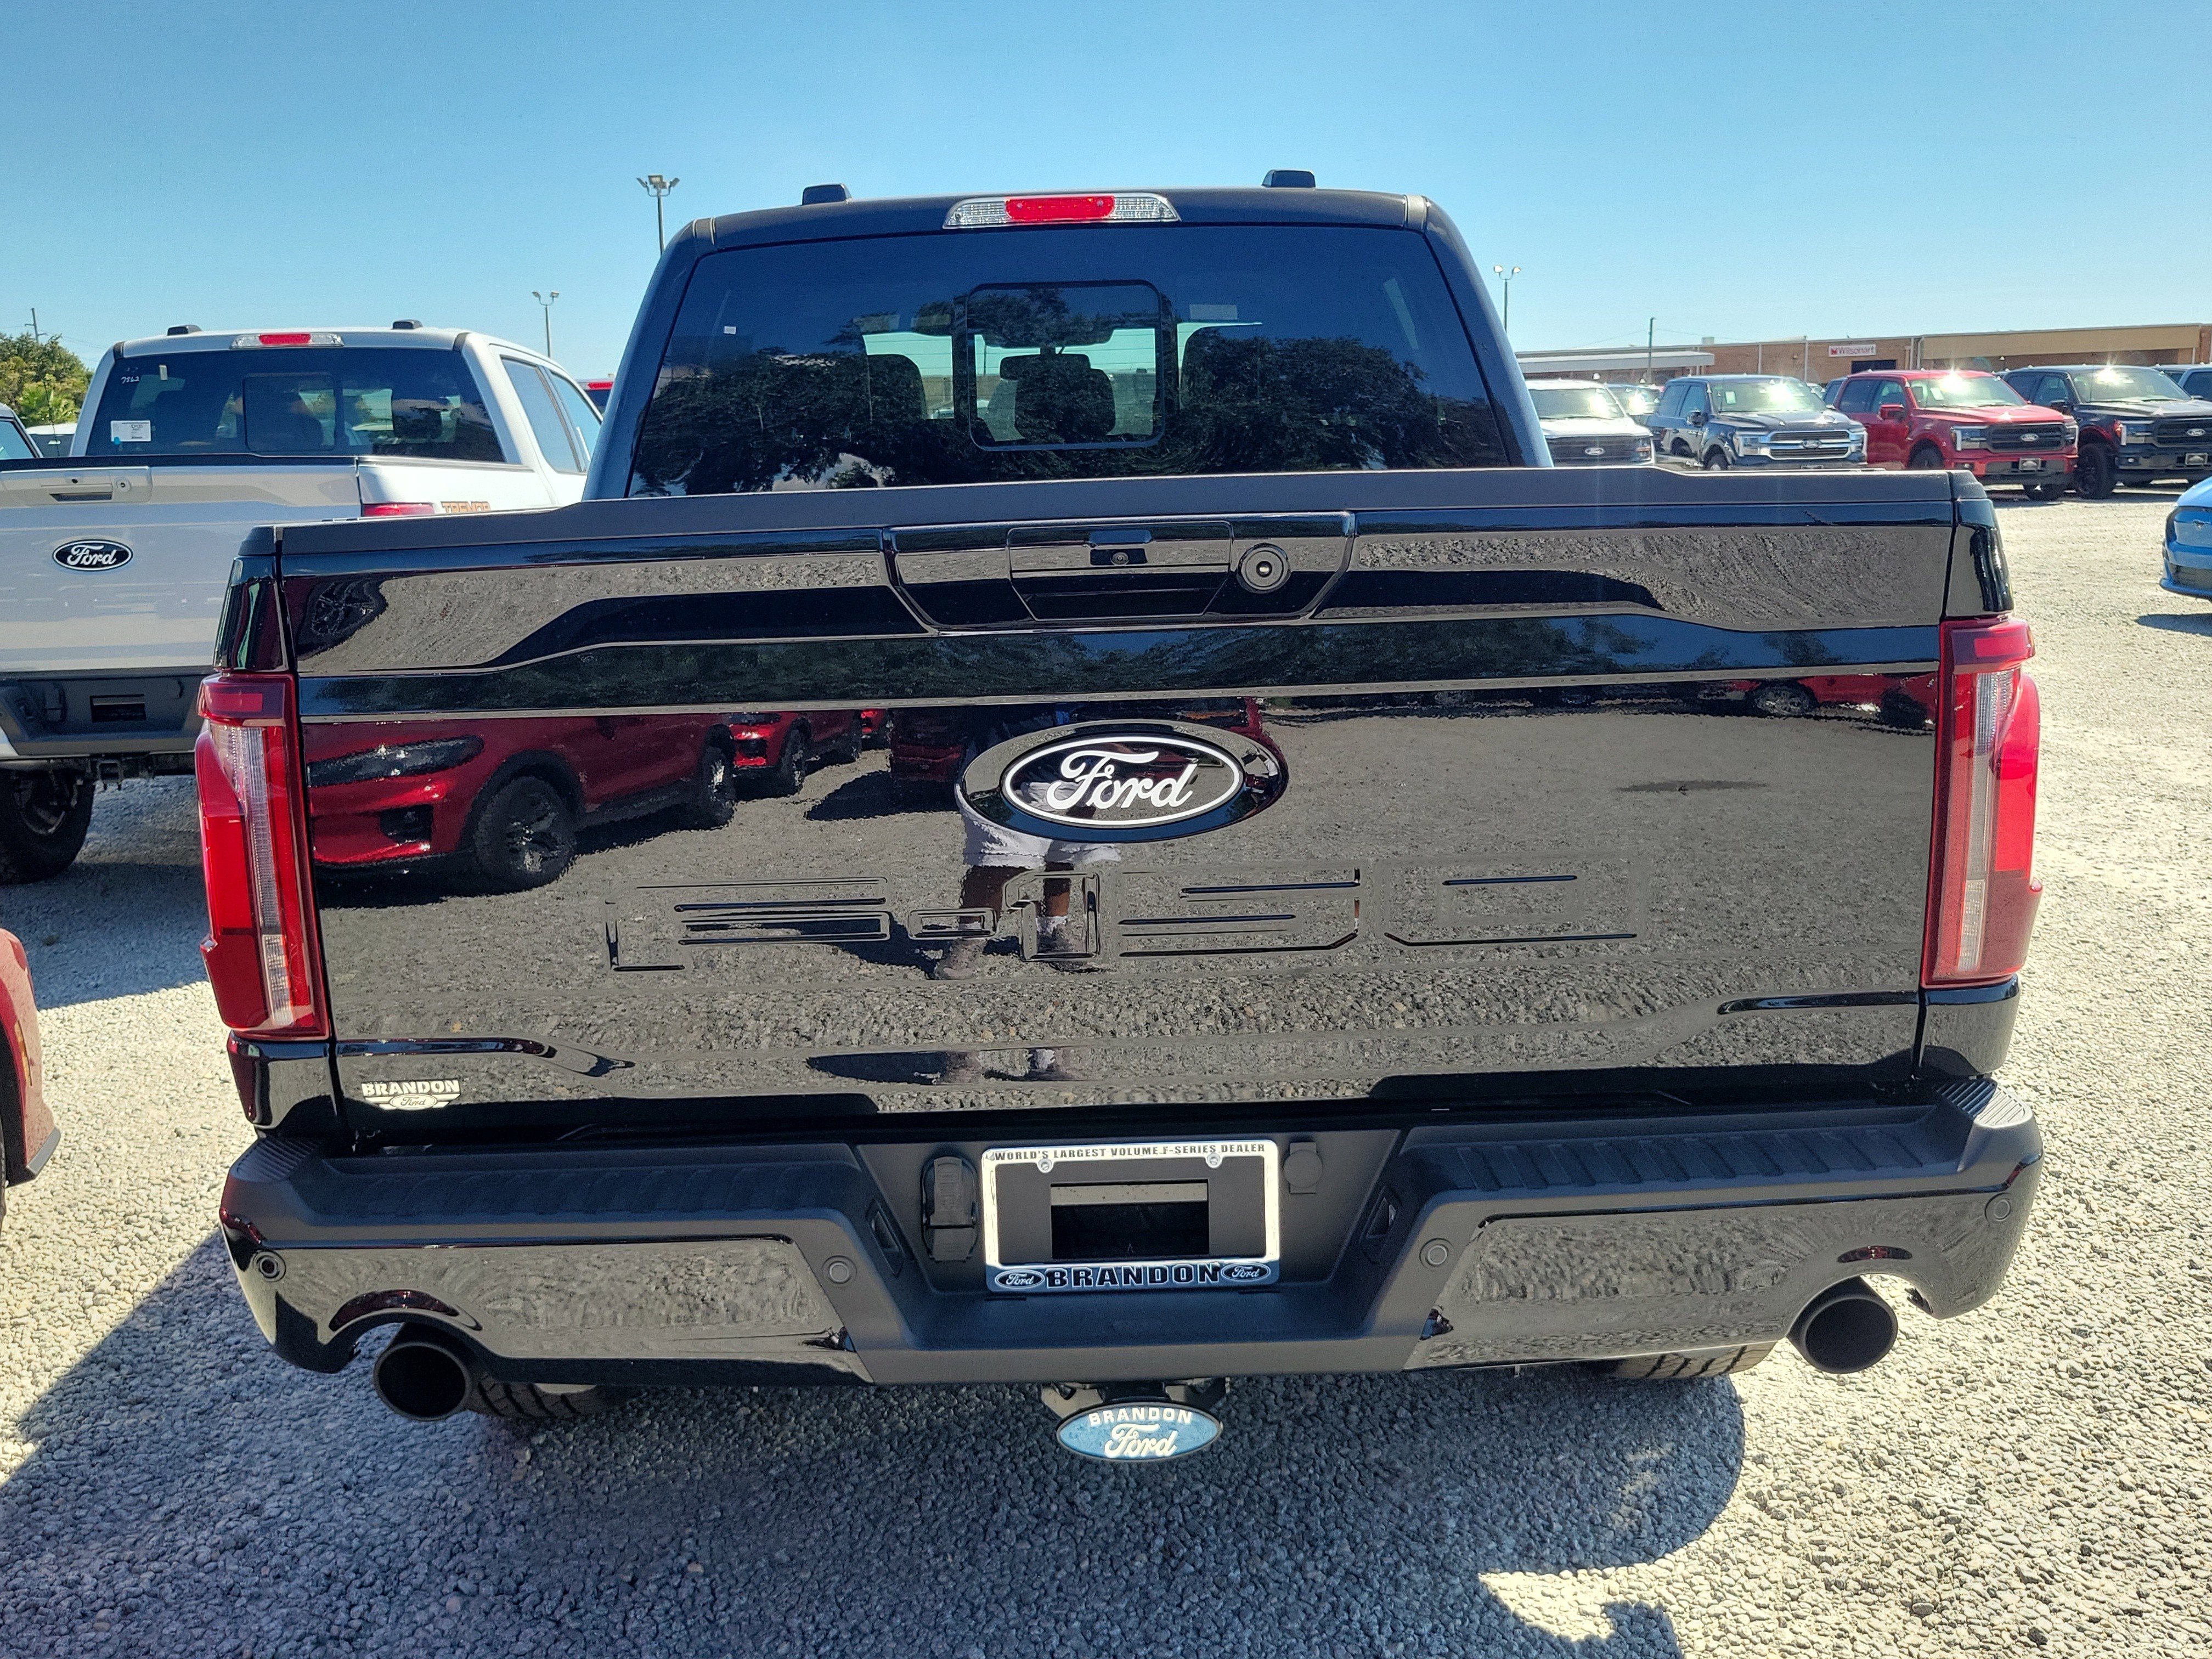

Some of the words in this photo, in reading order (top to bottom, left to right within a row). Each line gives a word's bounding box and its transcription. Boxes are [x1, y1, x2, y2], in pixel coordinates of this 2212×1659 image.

[67, 544, 117, 566] Ford
[1046, 750, 1198, 809] Ford
[362, 1080, 461, 1097] BRANDON
[400, 1096, 427, 1107] Ford
[995, 1150, 1049, 1160] WORLD'S
[1054, 1148, 1106, 1158] LARGEST
[1110, 1146, 1158, 1156] VOLUME
[1163, 1144, 1216, 1154] F-SERIES
[1221, 1143, 1265, 1153] DEALER
[1006, 1272, 1035, 1285] Ford
[1045, 1263, 1221, 1289] BRANDON
[1231, 1266, 1260, 1278] Ford
[1088, 1407, 1193, 1426] BRANDON
[1104, 1423, 1178, 1458] Ford
